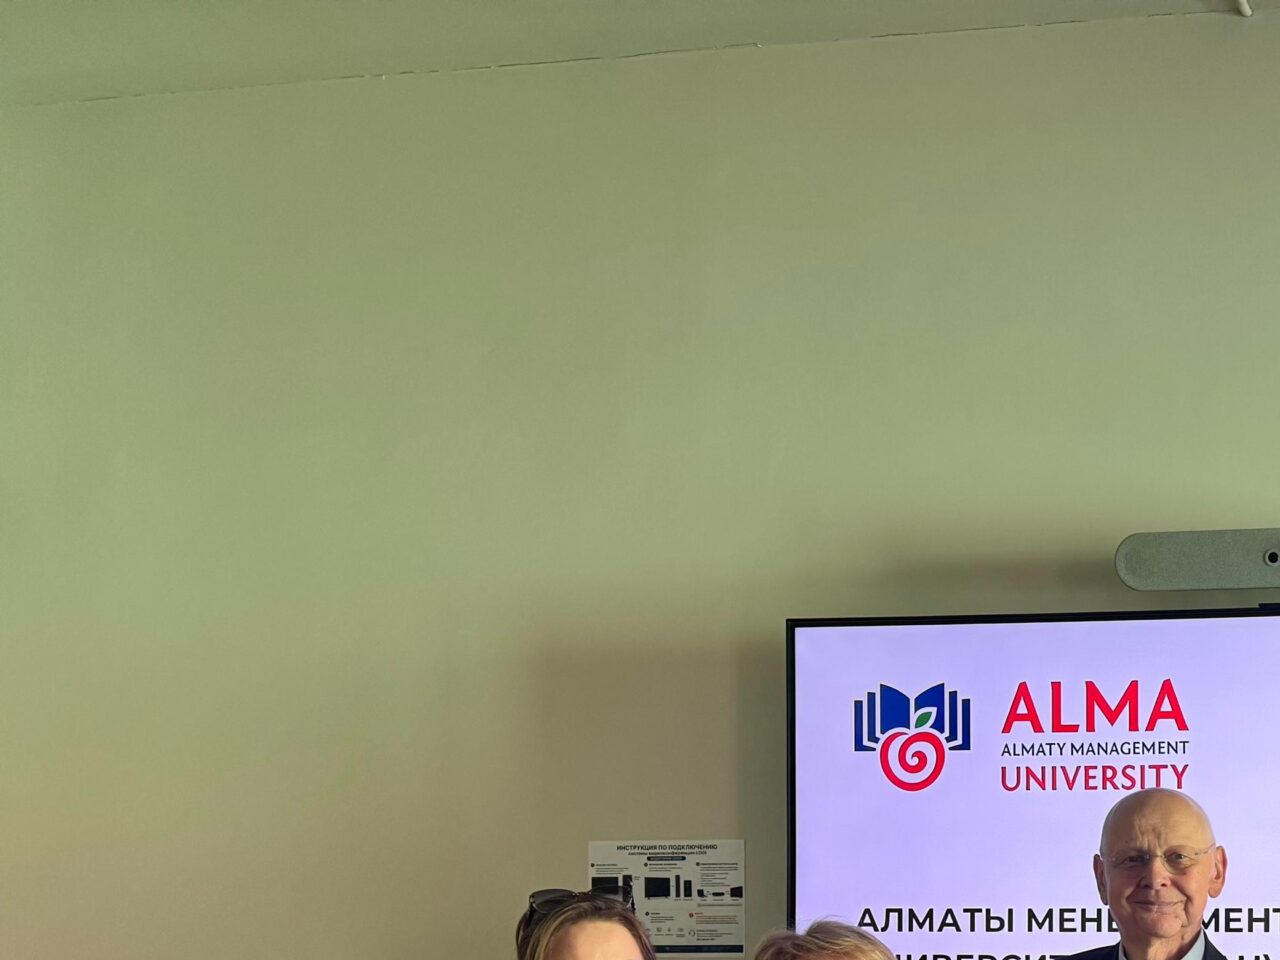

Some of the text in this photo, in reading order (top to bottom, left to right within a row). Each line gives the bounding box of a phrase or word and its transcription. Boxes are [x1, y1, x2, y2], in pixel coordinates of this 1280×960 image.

[1001, 678, 1190, 734] ALMA
[1001, 740, 1190, 757] ALMATY MANAGEMENT
[1001, 764, 1190, 792] UNIVERSITY
[858, 907, 1014, 932] АЛМАТЫ
